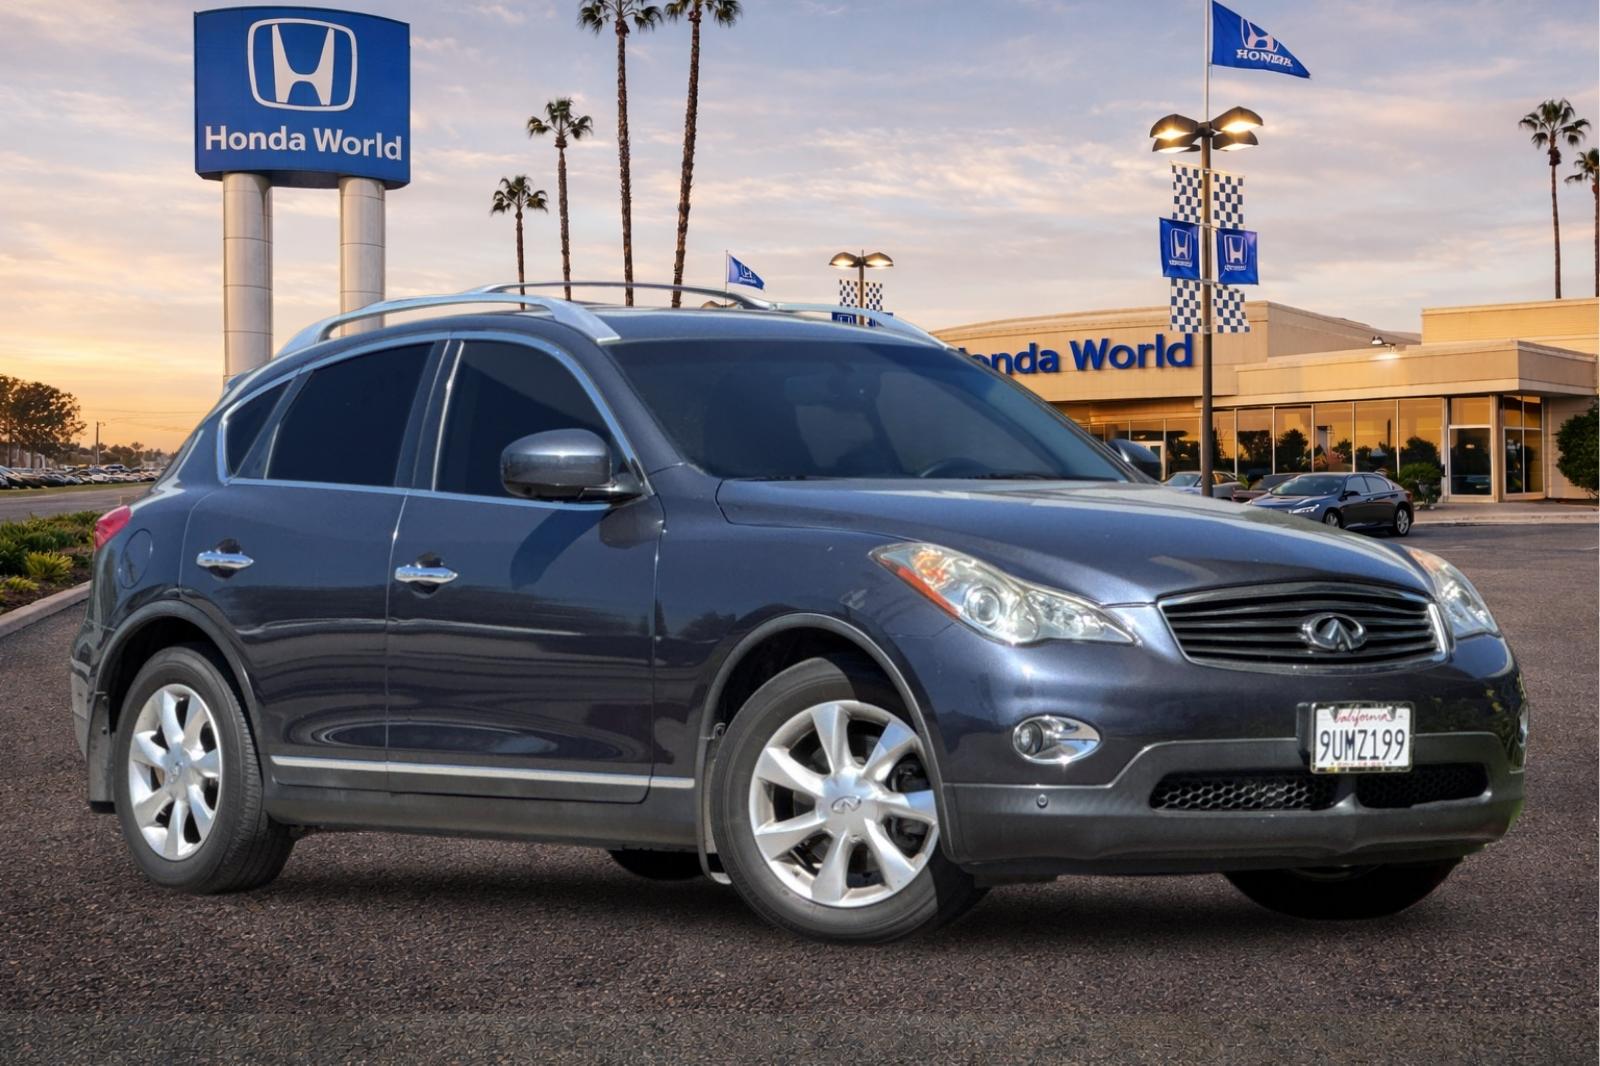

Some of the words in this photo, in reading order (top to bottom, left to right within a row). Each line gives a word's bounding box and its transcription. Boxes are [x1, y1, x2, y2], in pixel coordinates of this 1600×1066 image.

[205, 125, 306, 151] Honda
[312, 127, 402, 161] World
[958, 342, 1060, 375] nda
[1069, 333, 1193, 371] World
[1320, 729, 1405, 761] 9UMZ199
